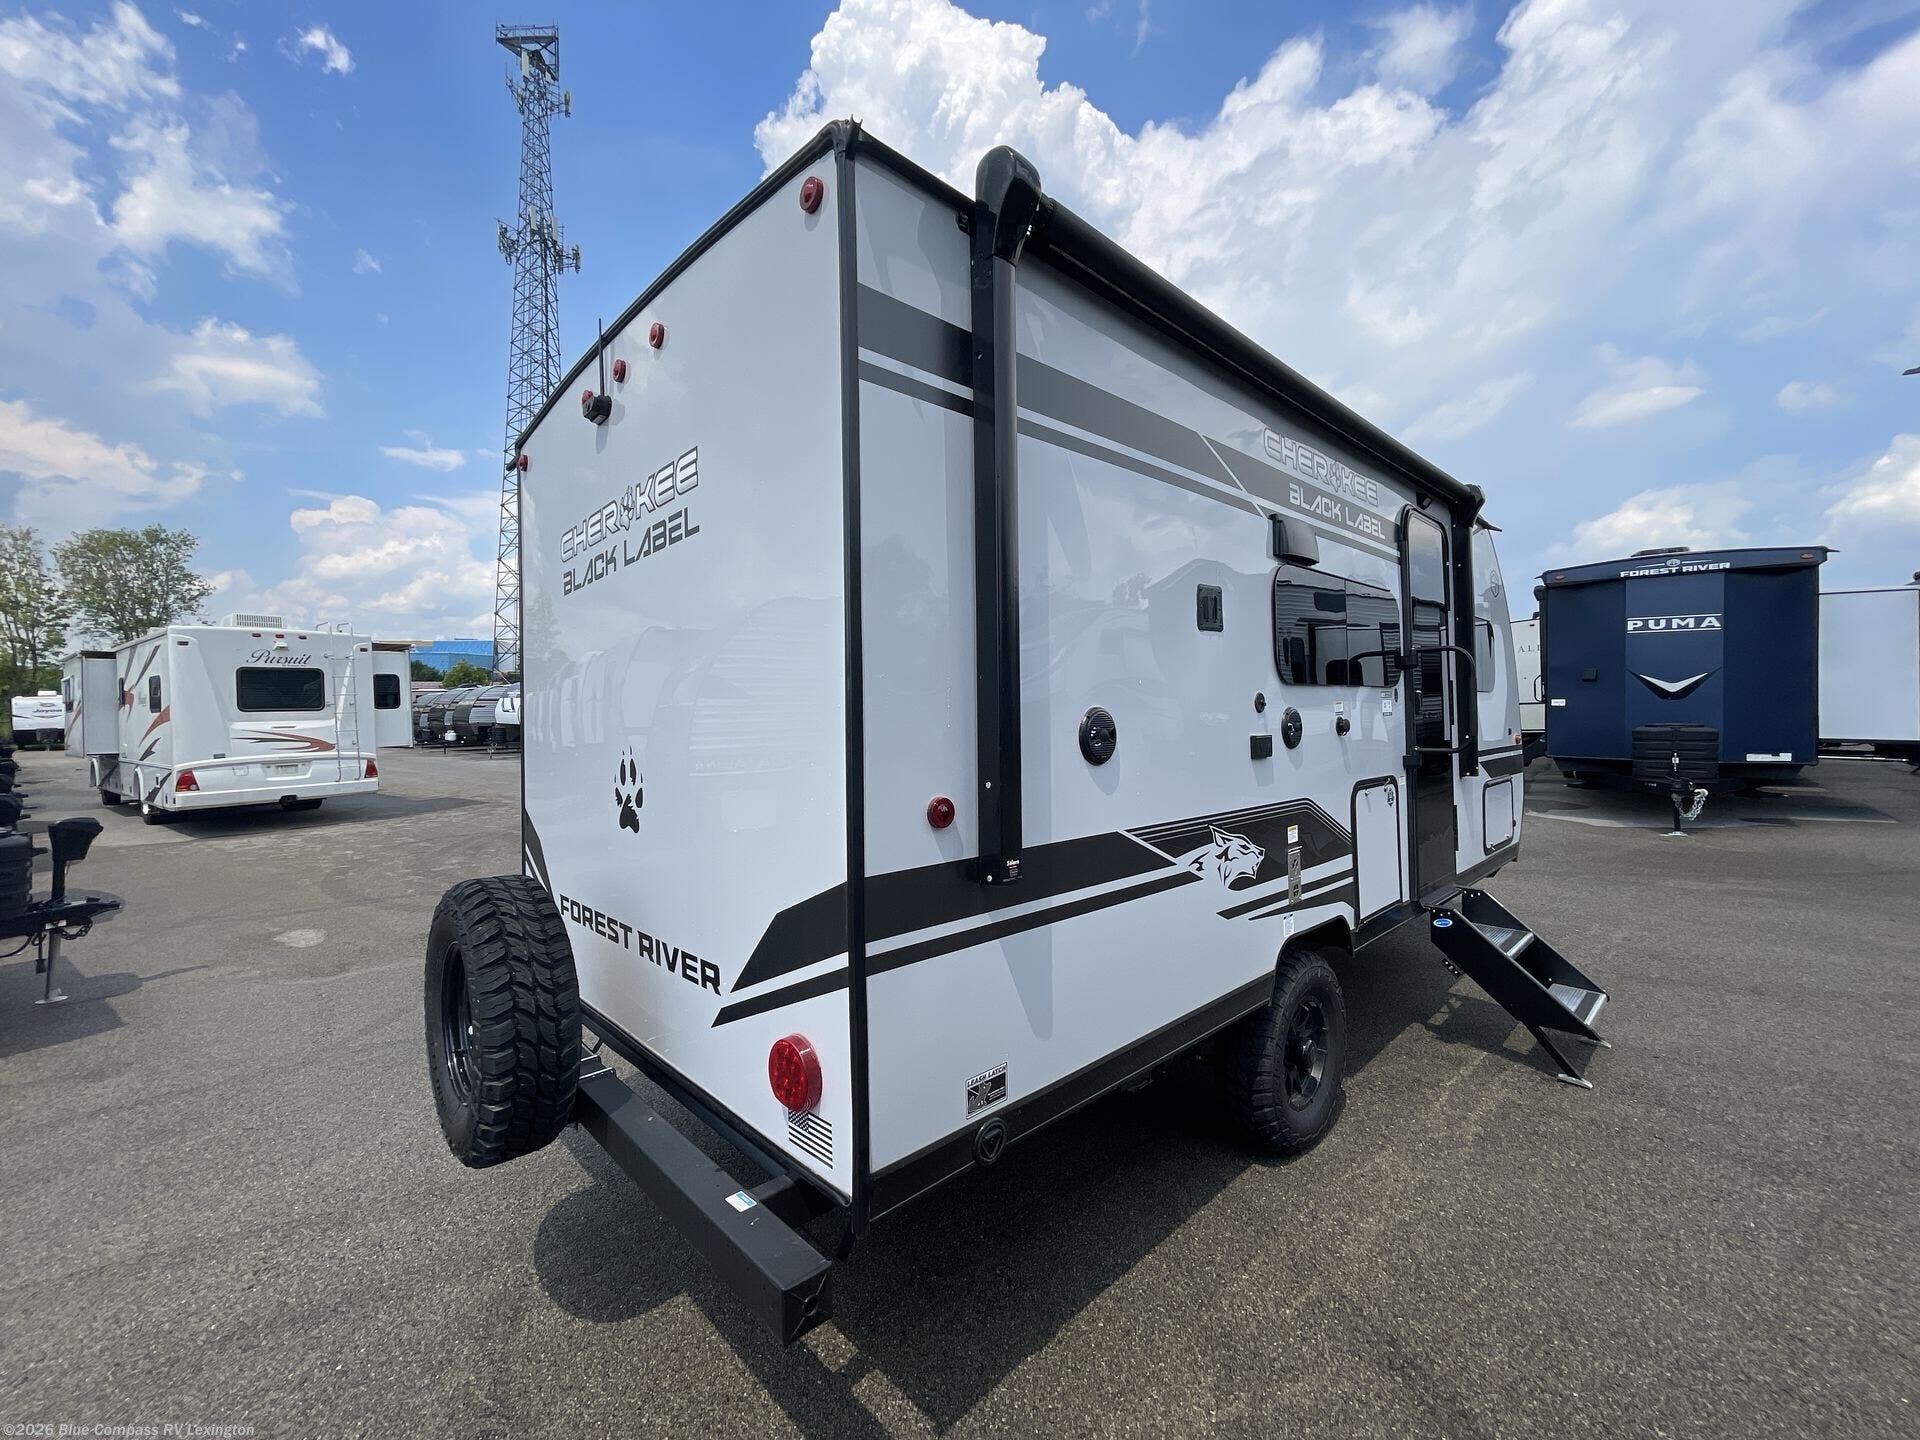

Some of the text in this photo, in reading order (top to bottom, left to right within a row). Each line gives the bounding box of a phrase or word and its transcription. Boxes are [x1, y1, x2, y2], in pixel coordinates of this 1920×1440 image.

[1263, 428, 1379, 507] CHEROKEE
[560, 446, 699, 563] CHEROKEE
[1289, 483, 1385, 539] BLACK LABEL
[563, 506, 700, 596] BLACK LABEL
[1620, 562, 1731, 578] FOREST RIVER
[1627, 616, 1722, 631] PUMA
[246, 649, 311, 664] Pursuit
[559, 894, 722, 996] FOREST RIVER
[967, 1066, 1006, 1088] LEASH LATCH
